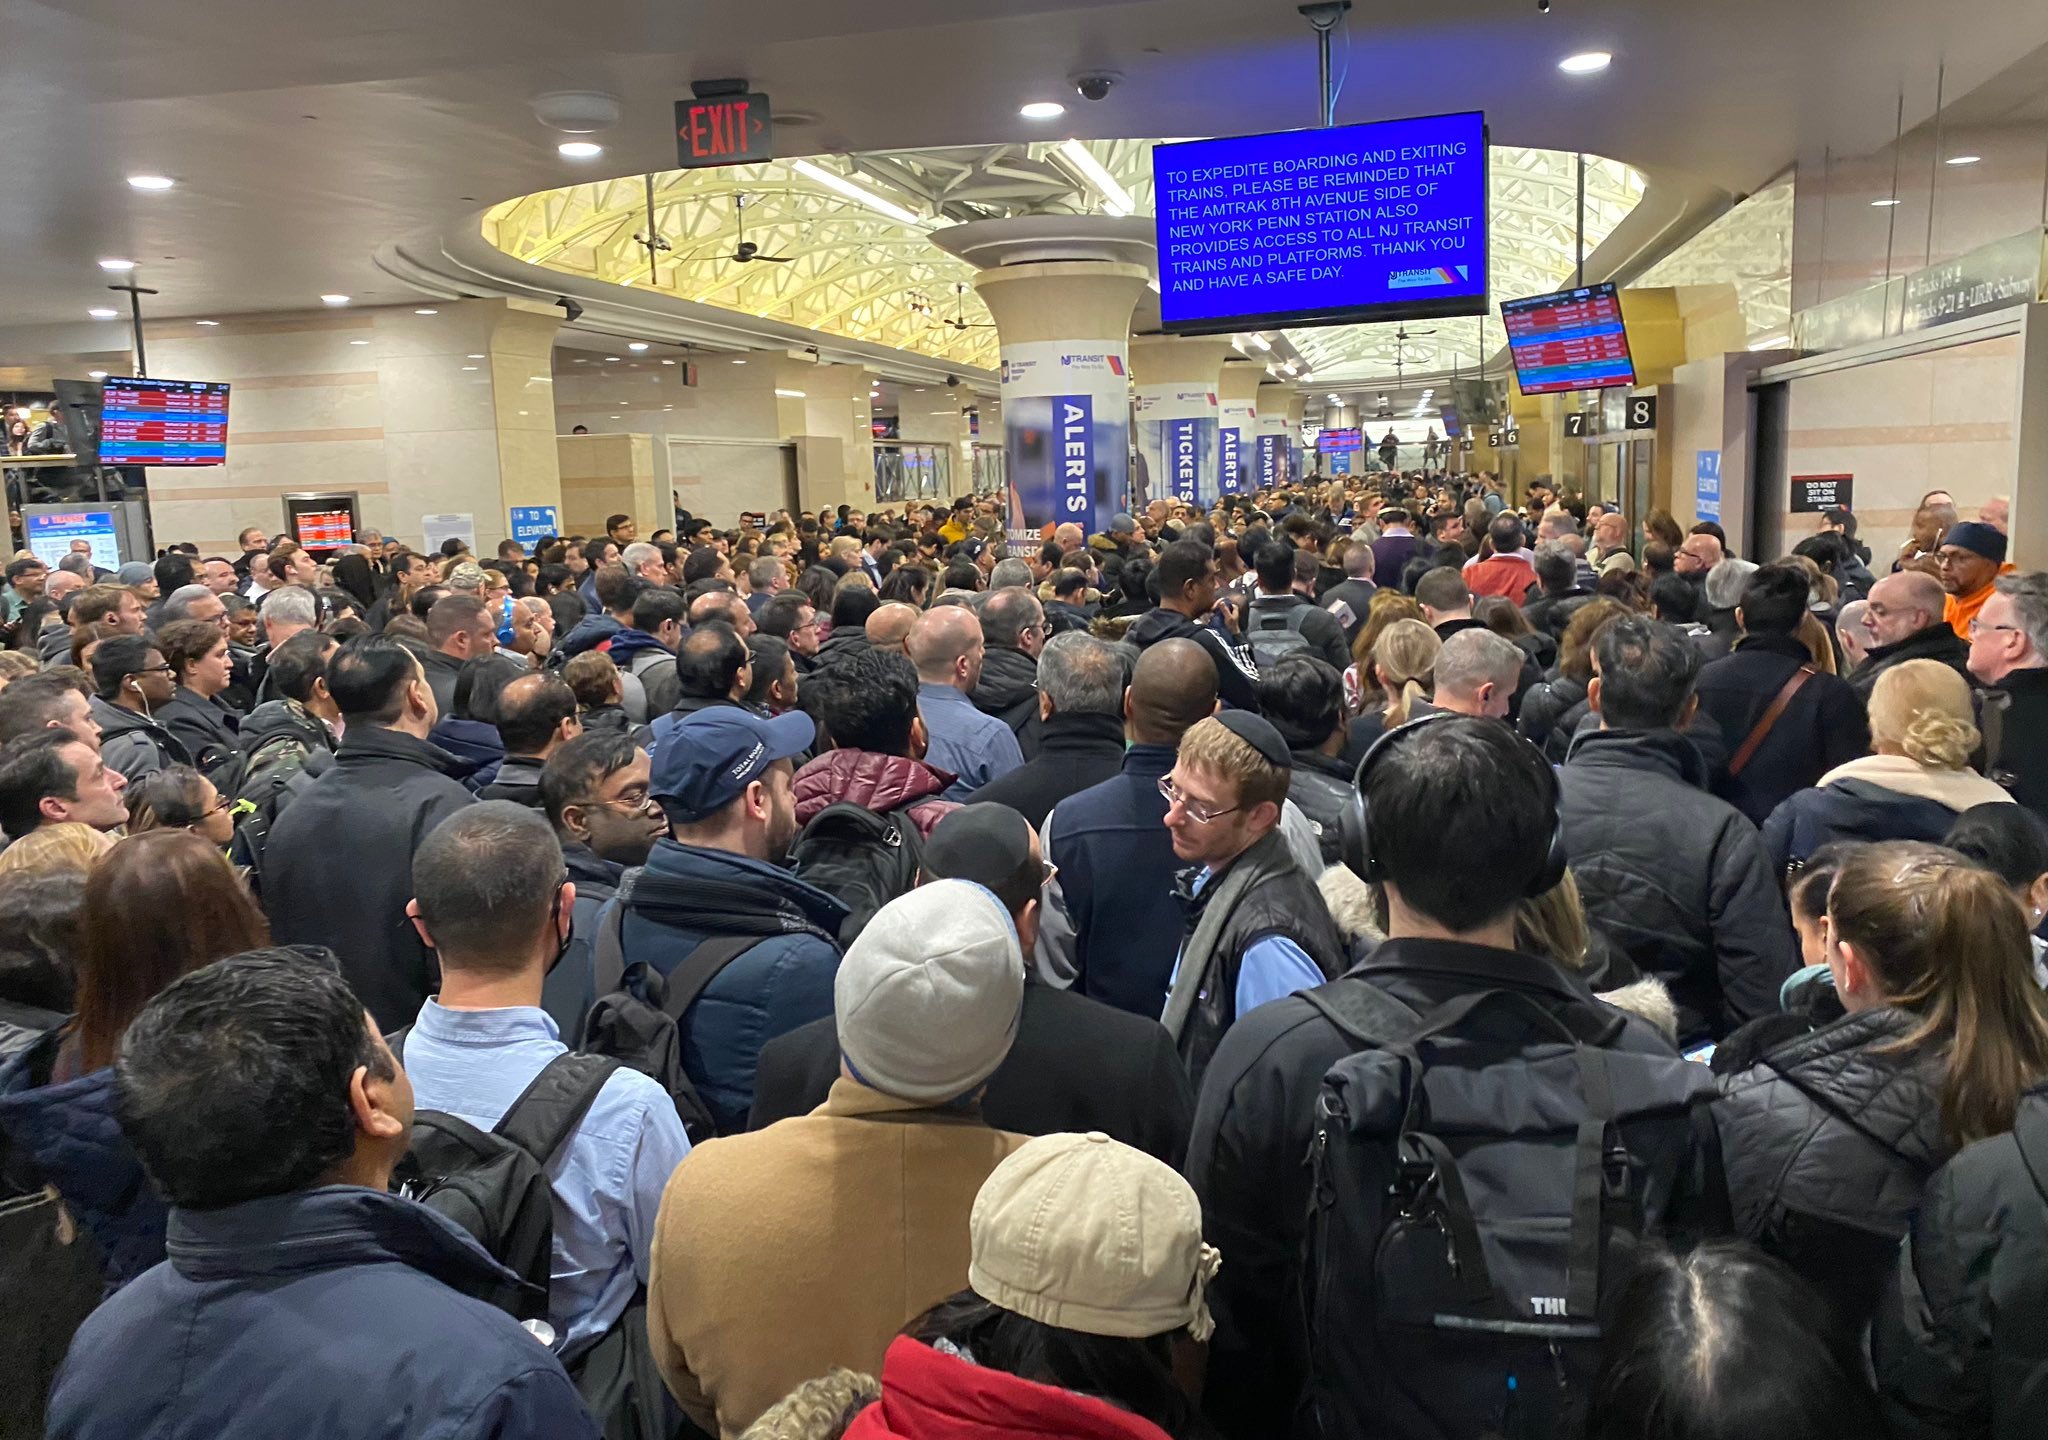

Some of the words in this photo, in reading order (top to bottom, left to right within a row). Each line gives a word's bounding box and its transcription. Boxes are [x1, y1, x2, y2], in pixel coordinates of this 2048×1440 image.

[689, 101, 749, 157] EXIT
[1167, 171, 1187, 184] TO
[1192, 162, 1268, 182] EXPEDITE
[1273, 153, 1358, 173] BOARDING
[1362, 149, 1396, 164] AND
[1401, 142, 1467, 160] EXITING
[1168, 185, 1228, 202] TRAINS,
[1233, 178, 1293, 196] PLEASE
[1298, 175, 1319, 189] BE
[1324, 167, 1409, 187] REMINDED
[1414, 162, 1455, 178] THAT
[1169, 206, 1199, 220] THE
[1202, 200, 1267, 217] AMTRAK
[1271, 196, 1301, 211] 8TH
[1305, 189, 1368, 207] AVENUE
[1374, 185, 1411, 200] SIDE
[1416, 183, 1439, 196] OF
[1170, 224, 1205, 238] NEW
[1209, 219, 1252, 235] YORK
[1258, 215, 1300, 229] PENN
[1305, 208, 1371, 226] STATION
[1375, 203, 1418, 219] ALSO
[1171, 238, 1249, 256] PROVIDES
[1253, 231, 1317, 249] ACCESS
[1322, 229, 1343, 242] TO
[1347, 226, 1375, 240] ALL
[1379, 224, 1399, 237] NJ
[1403, 216, 1473, 234] TRANSIT
[1172, 258, 1227, 274] TRAINS
[1231, 255, 1263, 269] AND
[1268, 246, 1367, 266] PLATFORMS.
[1372, 239, 1426, 256] THANK
[1430, 236, 1465, 250] YOU
[1172, 278, 1204, 293] AND
[1209, 274, 1248, 289] HAVE
[1253, 273, 1263, 285] A
[1266, 269, 1306, 284] SAFE
[1312, 265, 1344, 280] DAY.
[1570, 416, 1581, 434] 7
[1633, 401, 1650, 424] 8
[1491, 435, 1498, 446] 5
[1508, 431, 1516, 443] 6
[1064, 404, 1088, 512] ALERTS
[1179, 423, 1193, 502] TICKETS
[1225, 432, 1237, 489] ALERTS
[529, 511, 540, 520] TO
[732, 758, 751, 776] TOTAL
